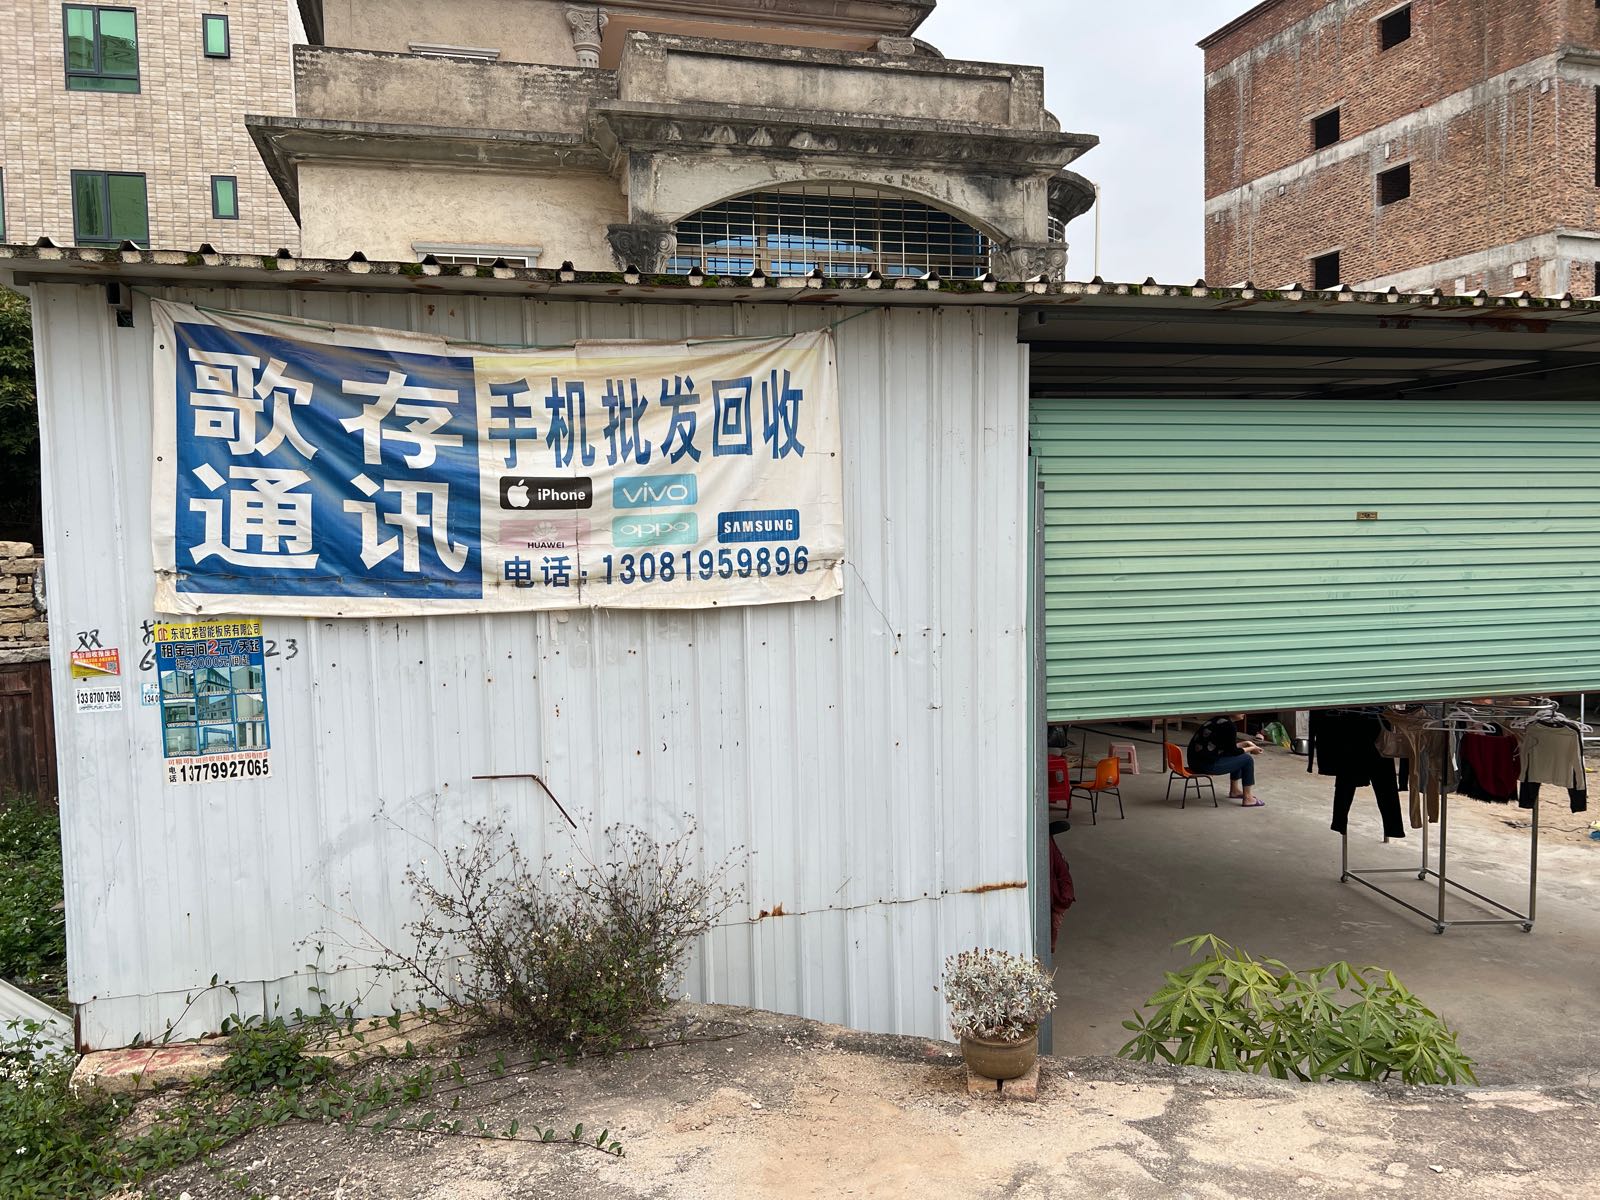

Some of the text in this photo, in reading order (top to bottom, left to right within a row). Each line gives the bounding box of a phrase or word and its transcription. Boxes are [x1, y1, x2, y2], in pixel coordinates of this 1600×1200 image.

[188, 347, 464, 469] 歌存
[488, 369, 806, 469] 手机批发回收
[537, 488, 586, 501] iPhone
[188, 462, 469, 573] 通讯
[723, 517, 794, 534] SAMSUNG
[527, 541, 565, 549] HUAWEI
[602, 546, 809, 585] 13081959896
[161, 639, 260, 658] 租金每间2元/天起
[168, 767, 177, 783] 电话
[180, 759, 269, 782] 13779927065
